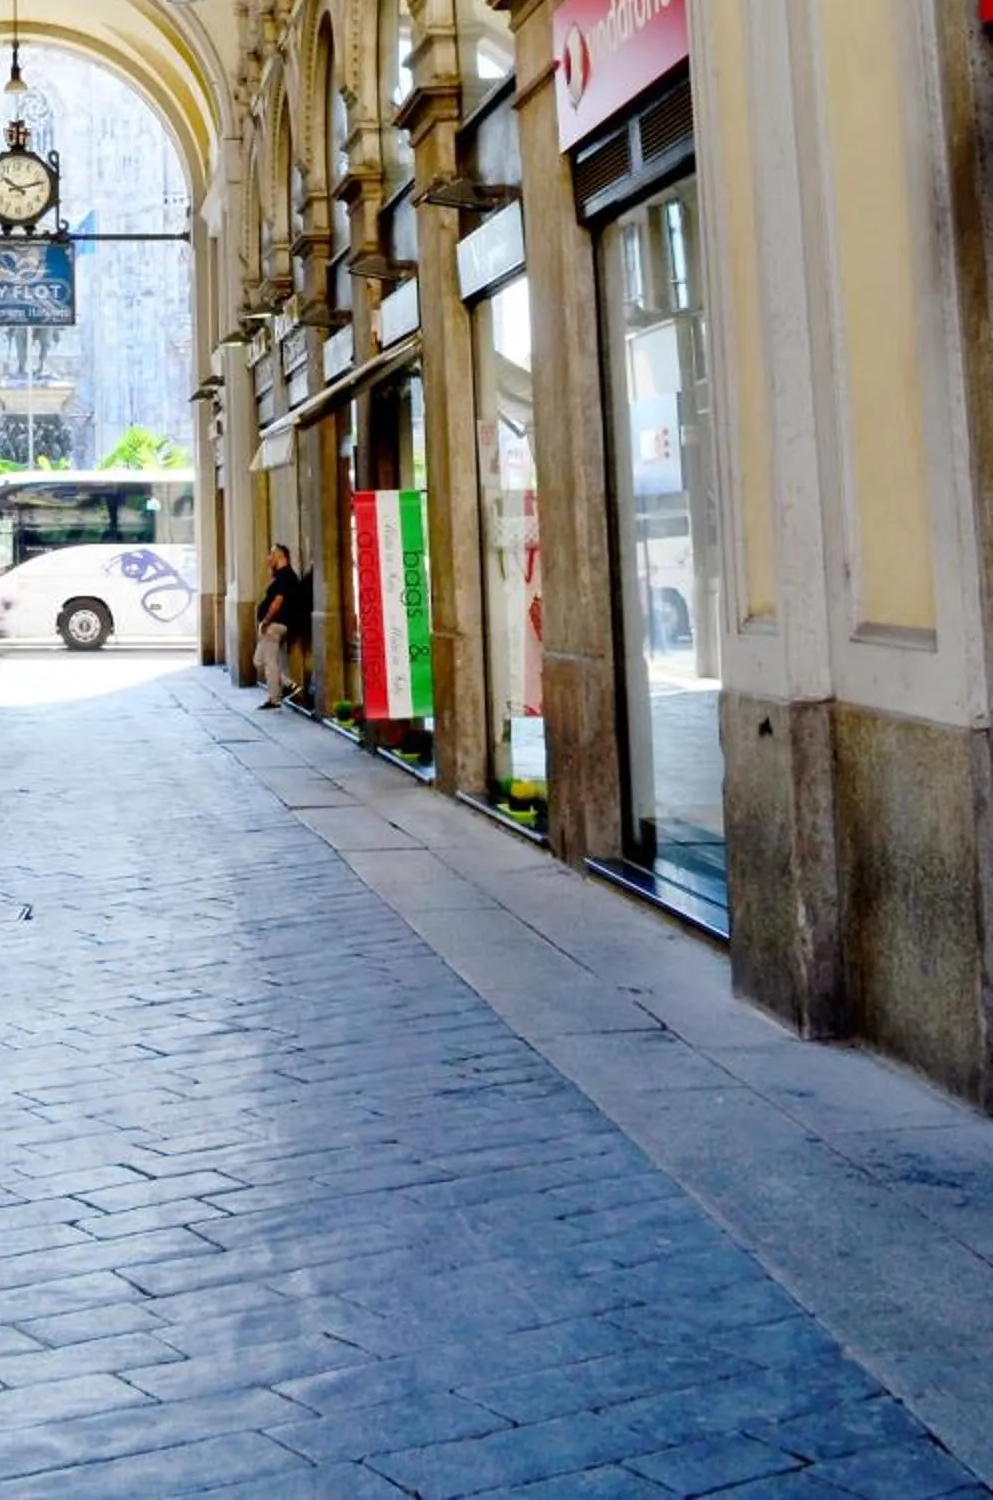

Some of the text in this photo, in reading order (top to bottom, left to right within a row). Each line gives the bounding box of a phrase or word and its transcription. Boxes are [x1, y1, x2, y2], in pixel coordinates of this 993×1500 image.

[13, 285, 62, 299] FLOT
[357, 531, 384, 690] accessories
[400, 550, 425, 619] bags
